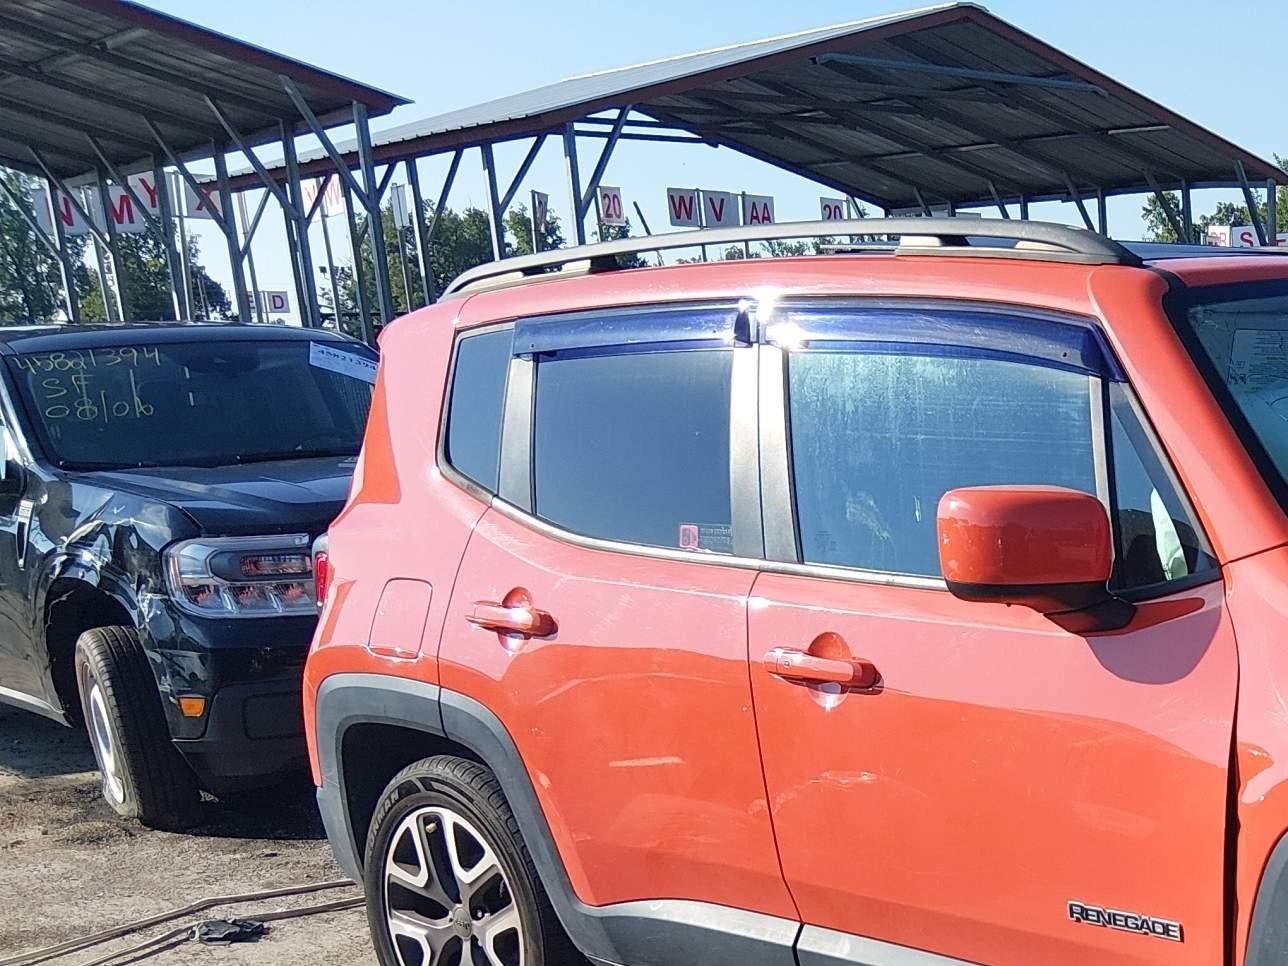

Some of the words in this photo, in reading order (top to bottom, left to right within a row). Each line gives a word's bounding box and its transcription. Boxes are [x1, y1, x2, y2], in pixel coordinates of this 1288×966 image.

[602, 192, 622, 219] 20
[669, 194, 694, 221] W
[708, 196, 725, 222] V
[750, 201, 772, 225] AA
[272, 294, 285, 310] D
[1067, 900, 1182, 942] RENEGADE
